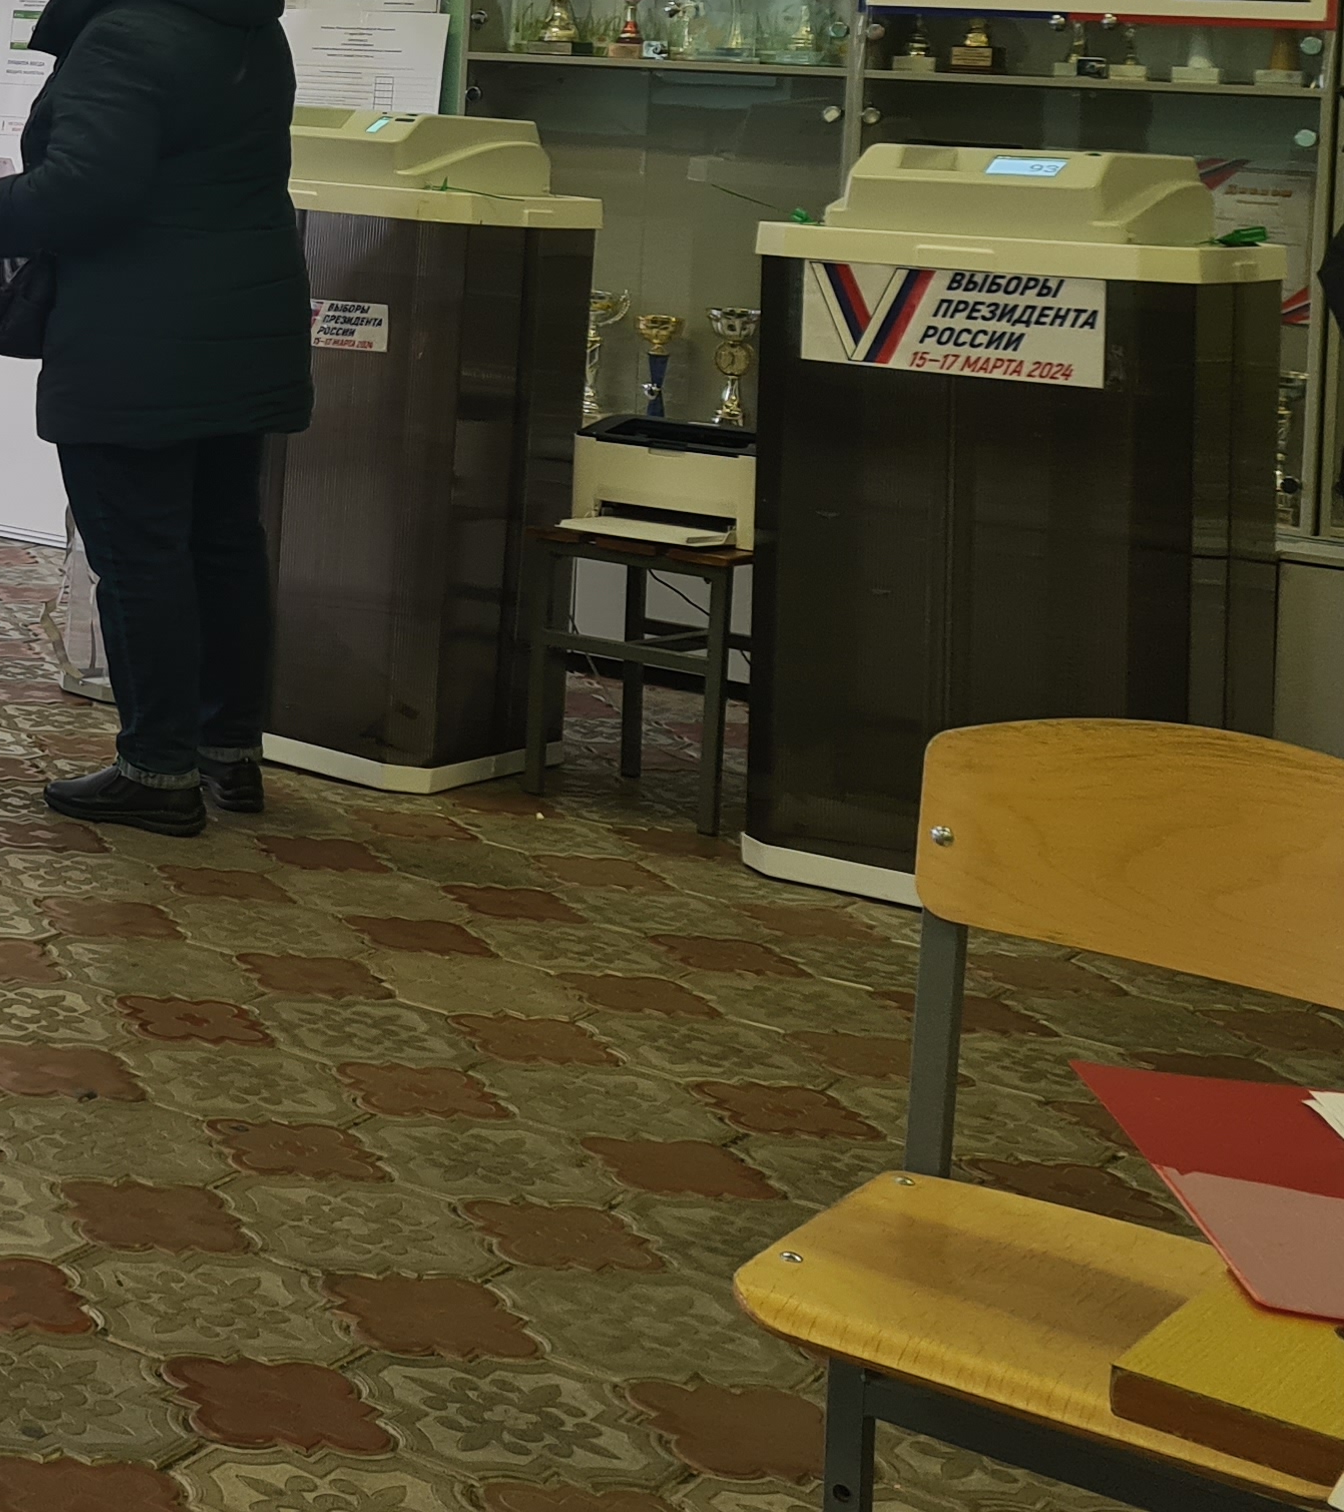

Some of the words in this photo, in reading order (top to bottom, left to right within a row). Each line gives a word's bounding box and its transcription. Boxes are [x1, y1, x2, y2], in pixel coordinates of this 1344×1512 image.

[946, 272, 1065, 298] ВЫБОРЫ
[322, 314, 384, 328] ПРЕЗИДЕНТА
[327, 303, 371, 314] ВЫБОРЫ
[931, 299, 1100, 329] ПРЕЗИДЕНТА
[317, 326, 357, 337] РОССИИ
[918, 325, 1026, 352] РОССИИ
[959, 355, 1025, 377] МАРТА
[1026, 361, 1074, 381] 2024
